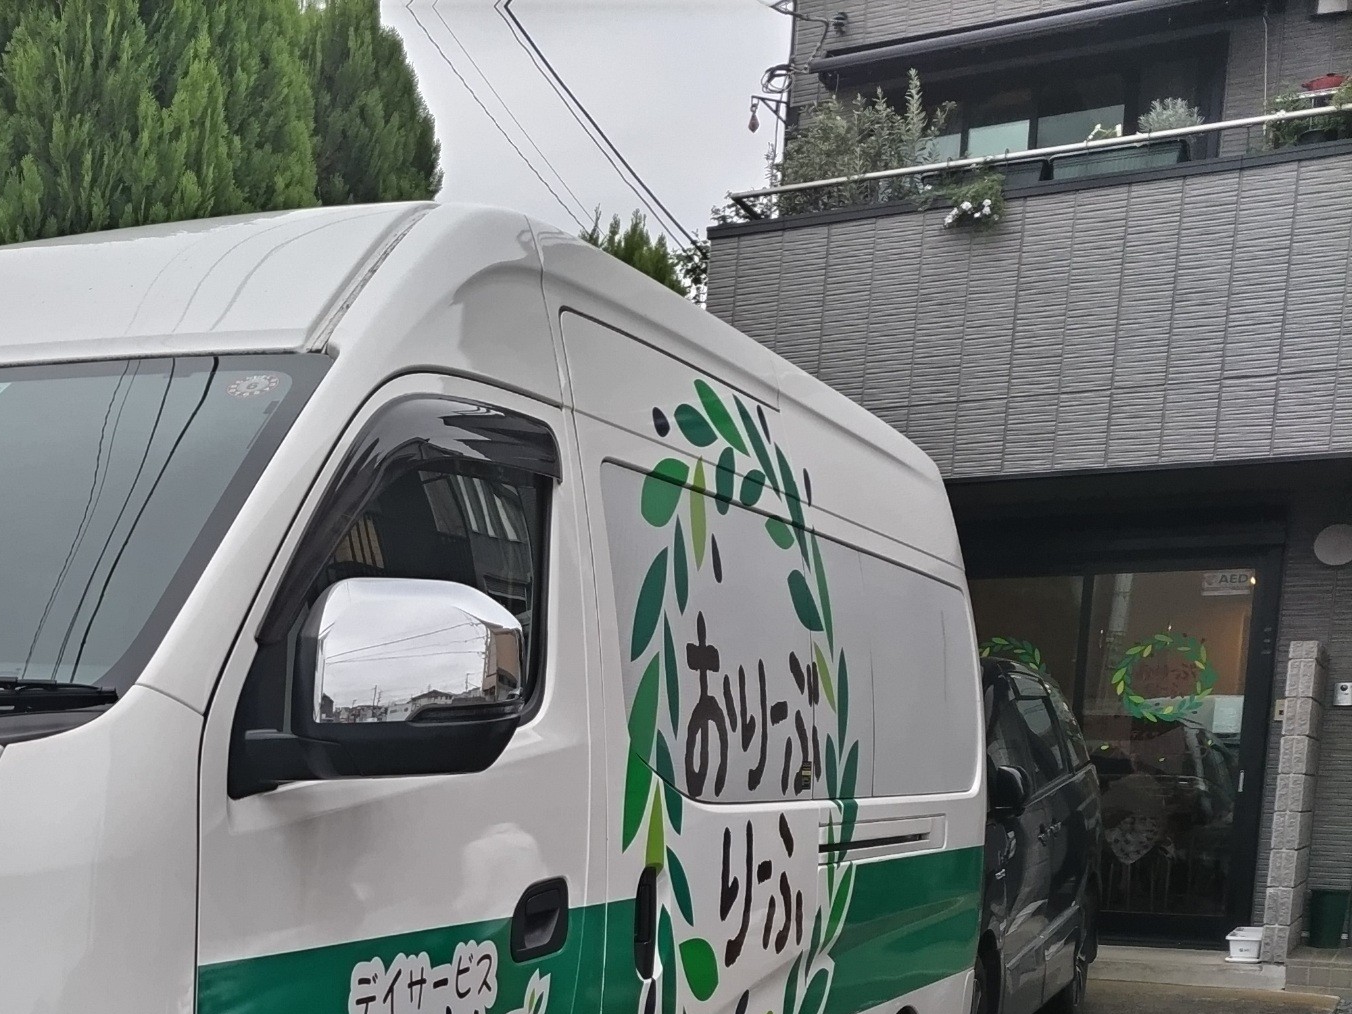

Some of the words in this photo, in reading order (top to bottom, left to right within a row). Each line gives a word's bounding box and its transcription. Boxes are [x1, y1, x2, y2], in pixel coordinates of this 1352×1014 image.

[1218, 573, 1248, 584] AED
[684, 610, 822, 798] おりーぶ
[719, 812, 804, 968] りーふ
